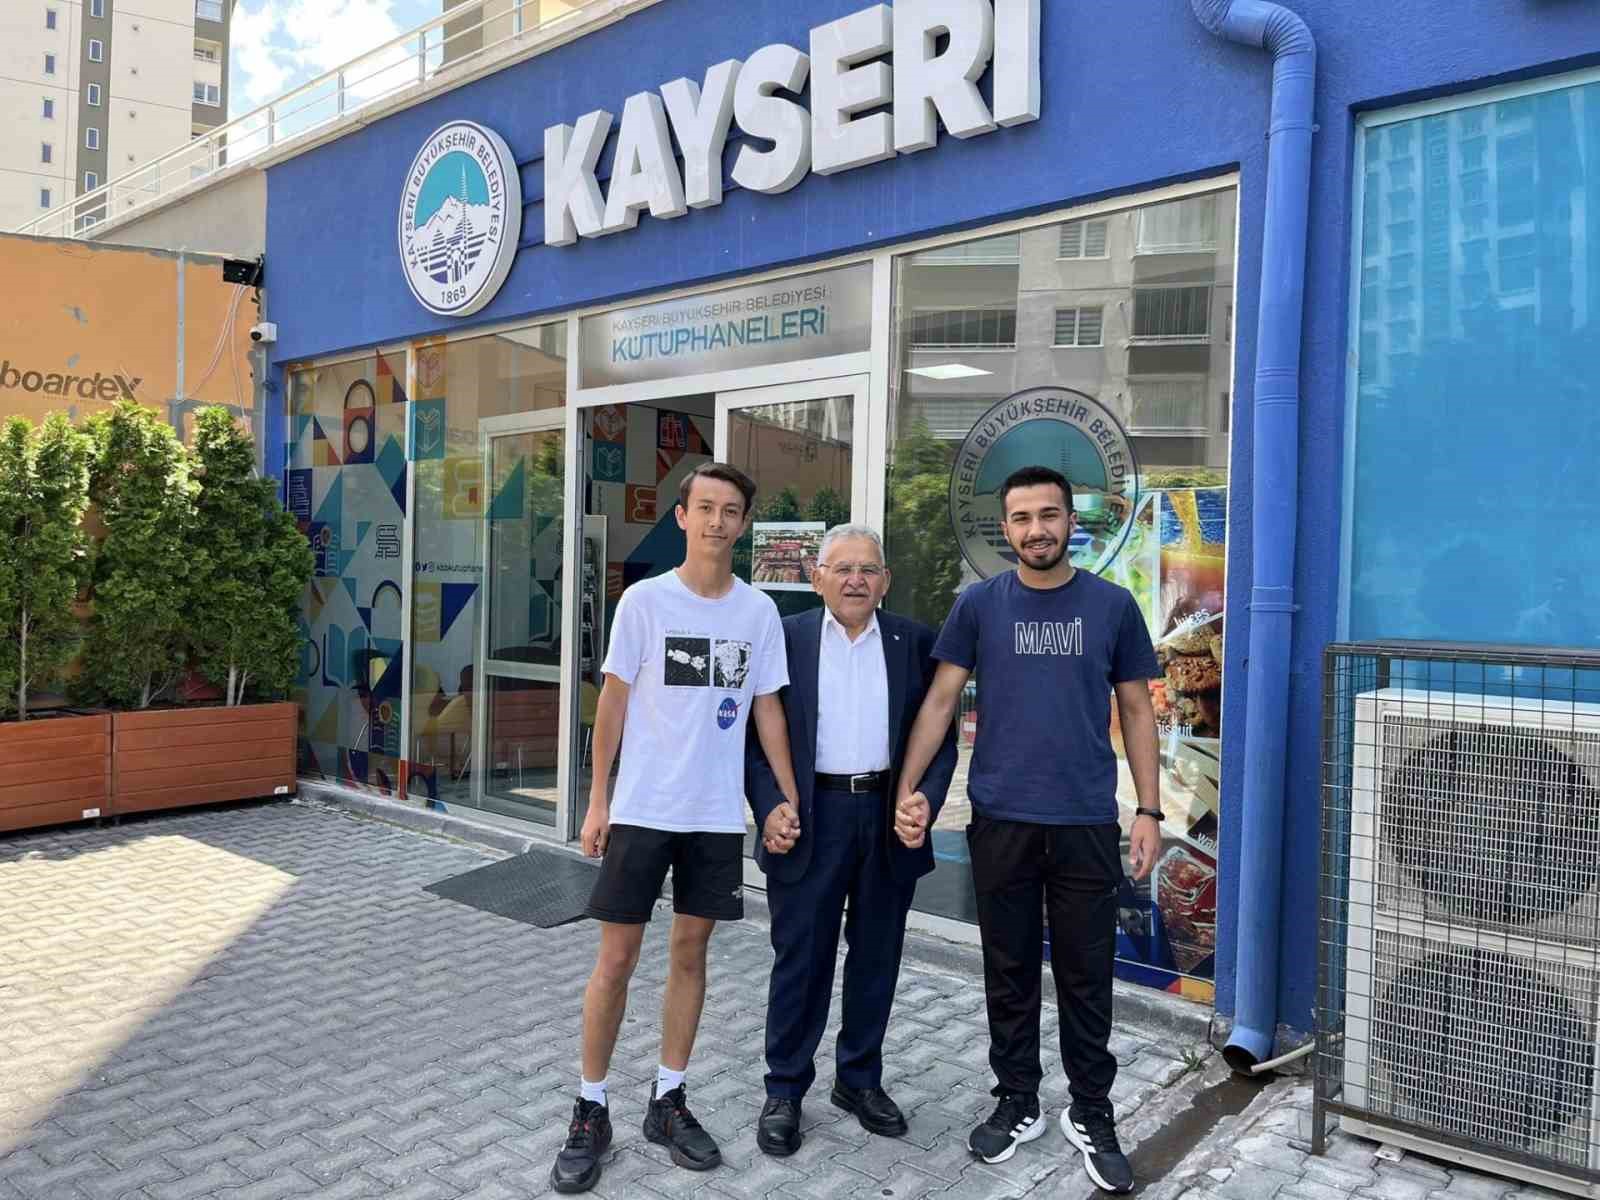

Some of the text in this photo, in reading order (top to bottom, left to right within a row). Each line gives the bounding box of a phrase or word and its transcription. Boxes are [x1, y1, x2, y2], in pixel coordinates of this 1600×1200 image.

[441, 285, 466, 304] 1869
[612, 305, 825, 362] KÜTÜPHANELERİ
[1015, 617, 1083, 655] MAVİ
[719, 709, 736, 718] NASA
